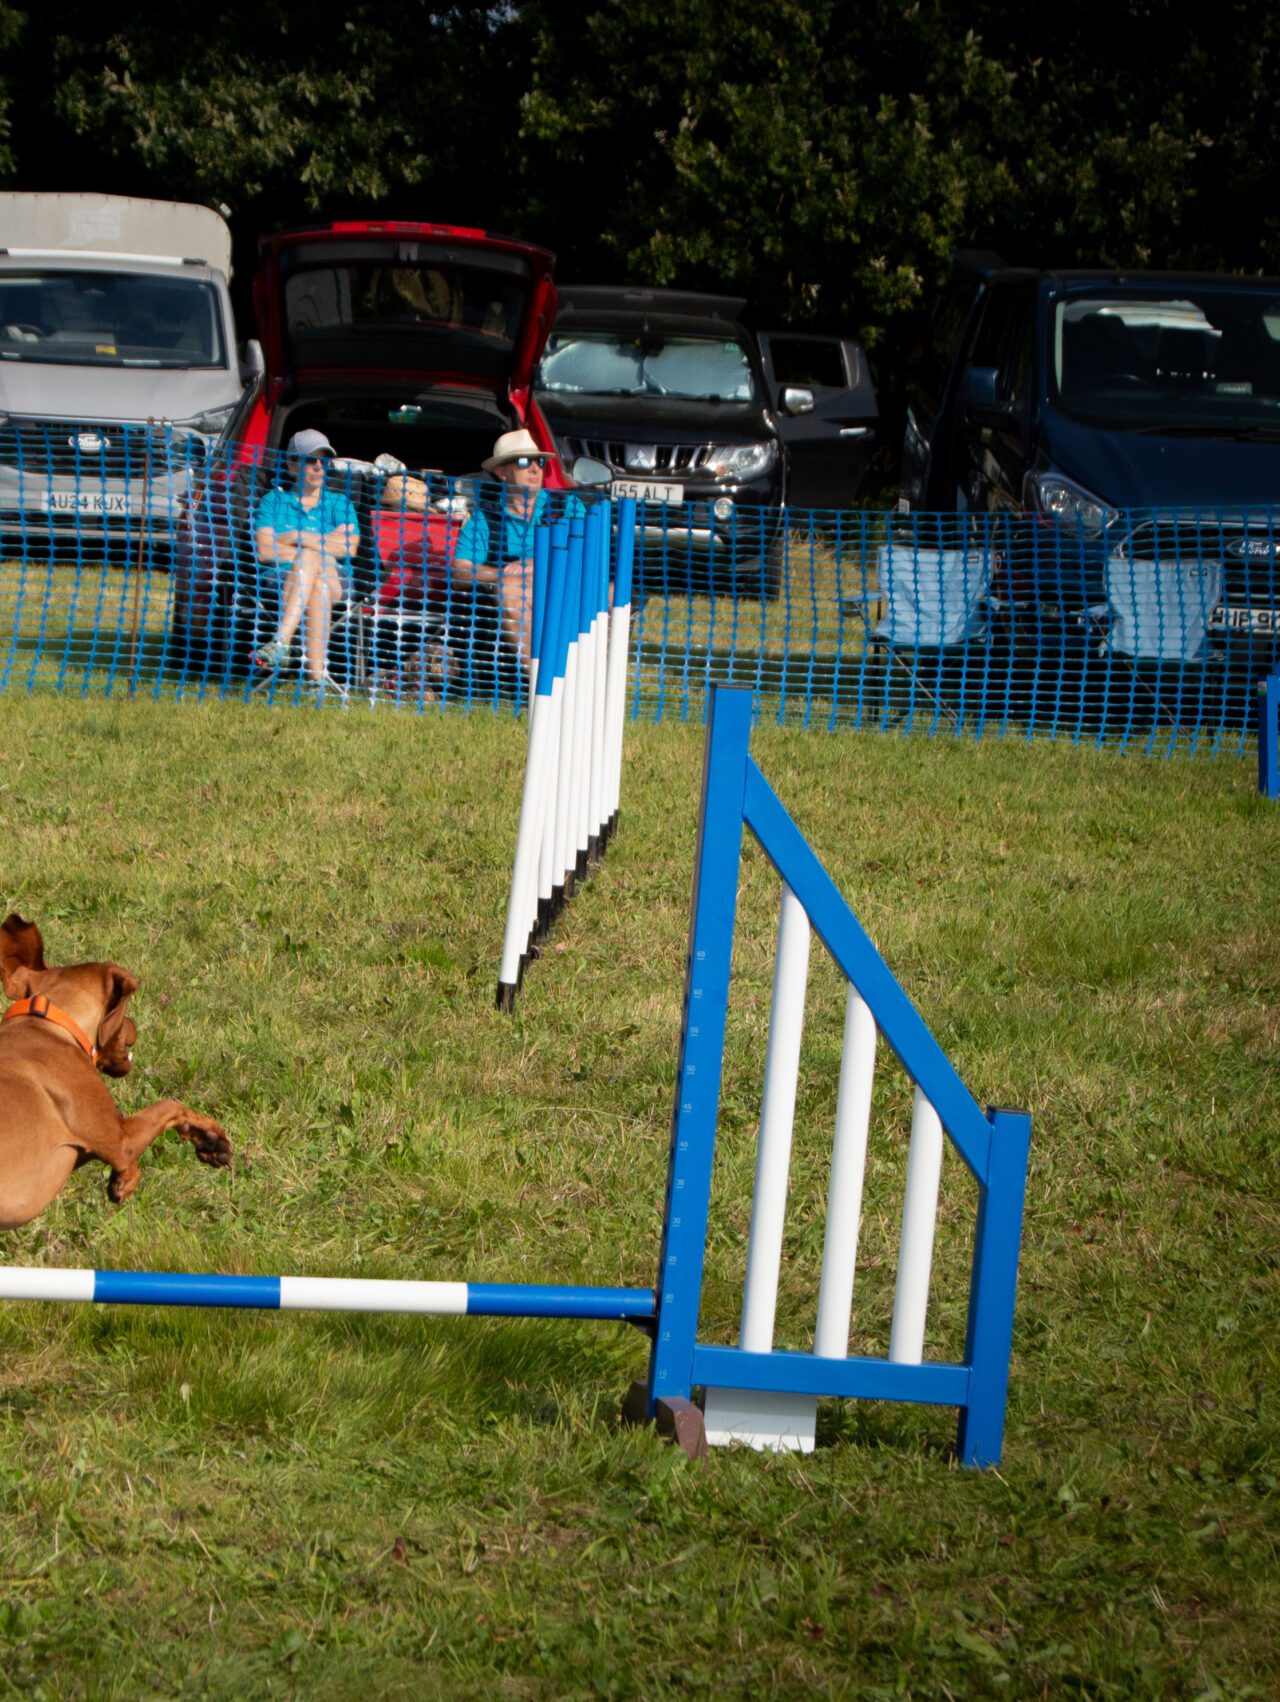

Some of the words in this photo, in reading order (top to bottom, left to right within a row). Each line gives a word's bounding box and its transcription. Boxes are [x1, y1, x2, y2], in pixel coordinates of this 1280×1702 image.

[644, 486, 673, 501] ALT
[49, 494, 88, 509] AU24
[93, 496, 124, 511] KJX
